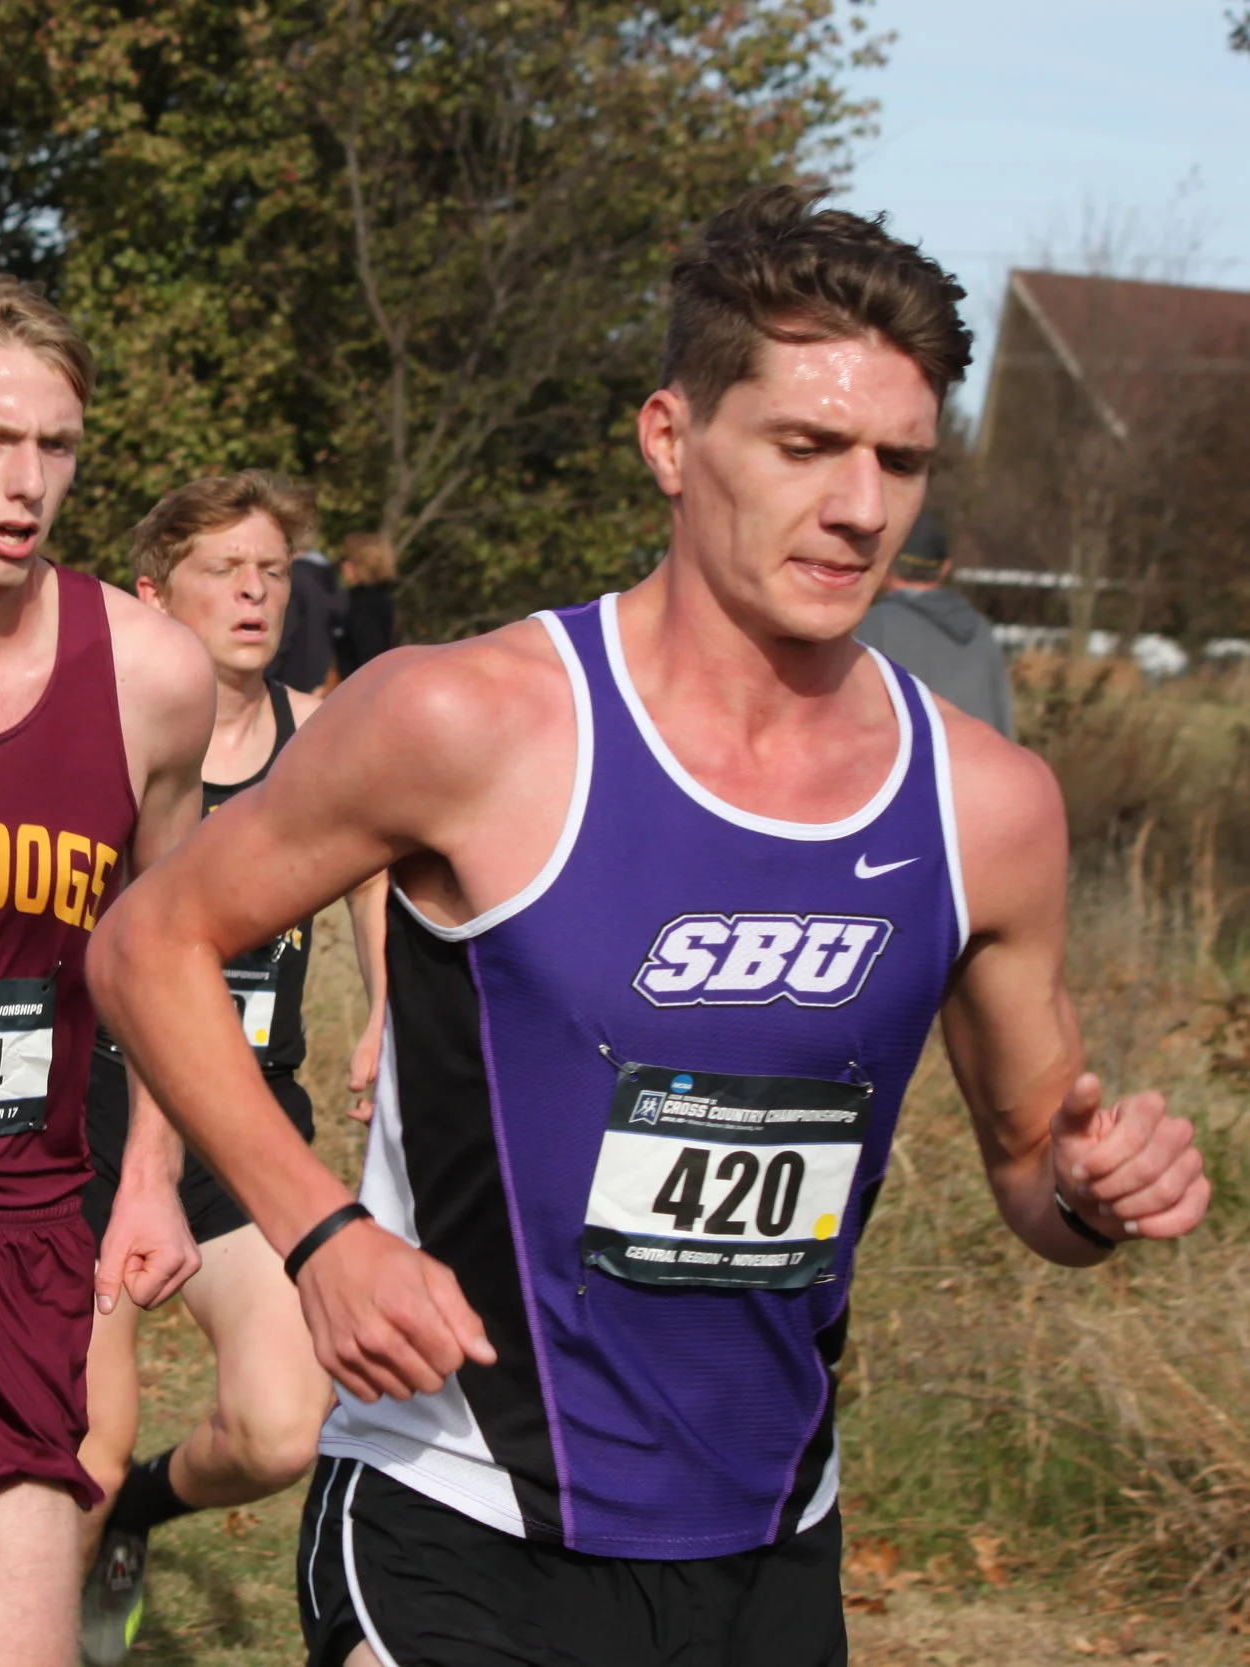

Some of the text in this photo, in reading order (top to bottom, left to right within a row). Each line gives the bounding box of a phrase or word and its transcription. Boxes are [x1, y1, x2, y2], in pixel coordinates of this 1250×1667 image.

[634, 914, 893, 1006] SBU
[7, 1107, 18, 1118] 17
[662, 1100, 858, 1123] CROSS COUNTRY CHAMPIONSHIPS
[652, 1146, 805, 1238] 420
[624, 1246, 806, 1266] CENTRAL REGION NOVEMBER 17
